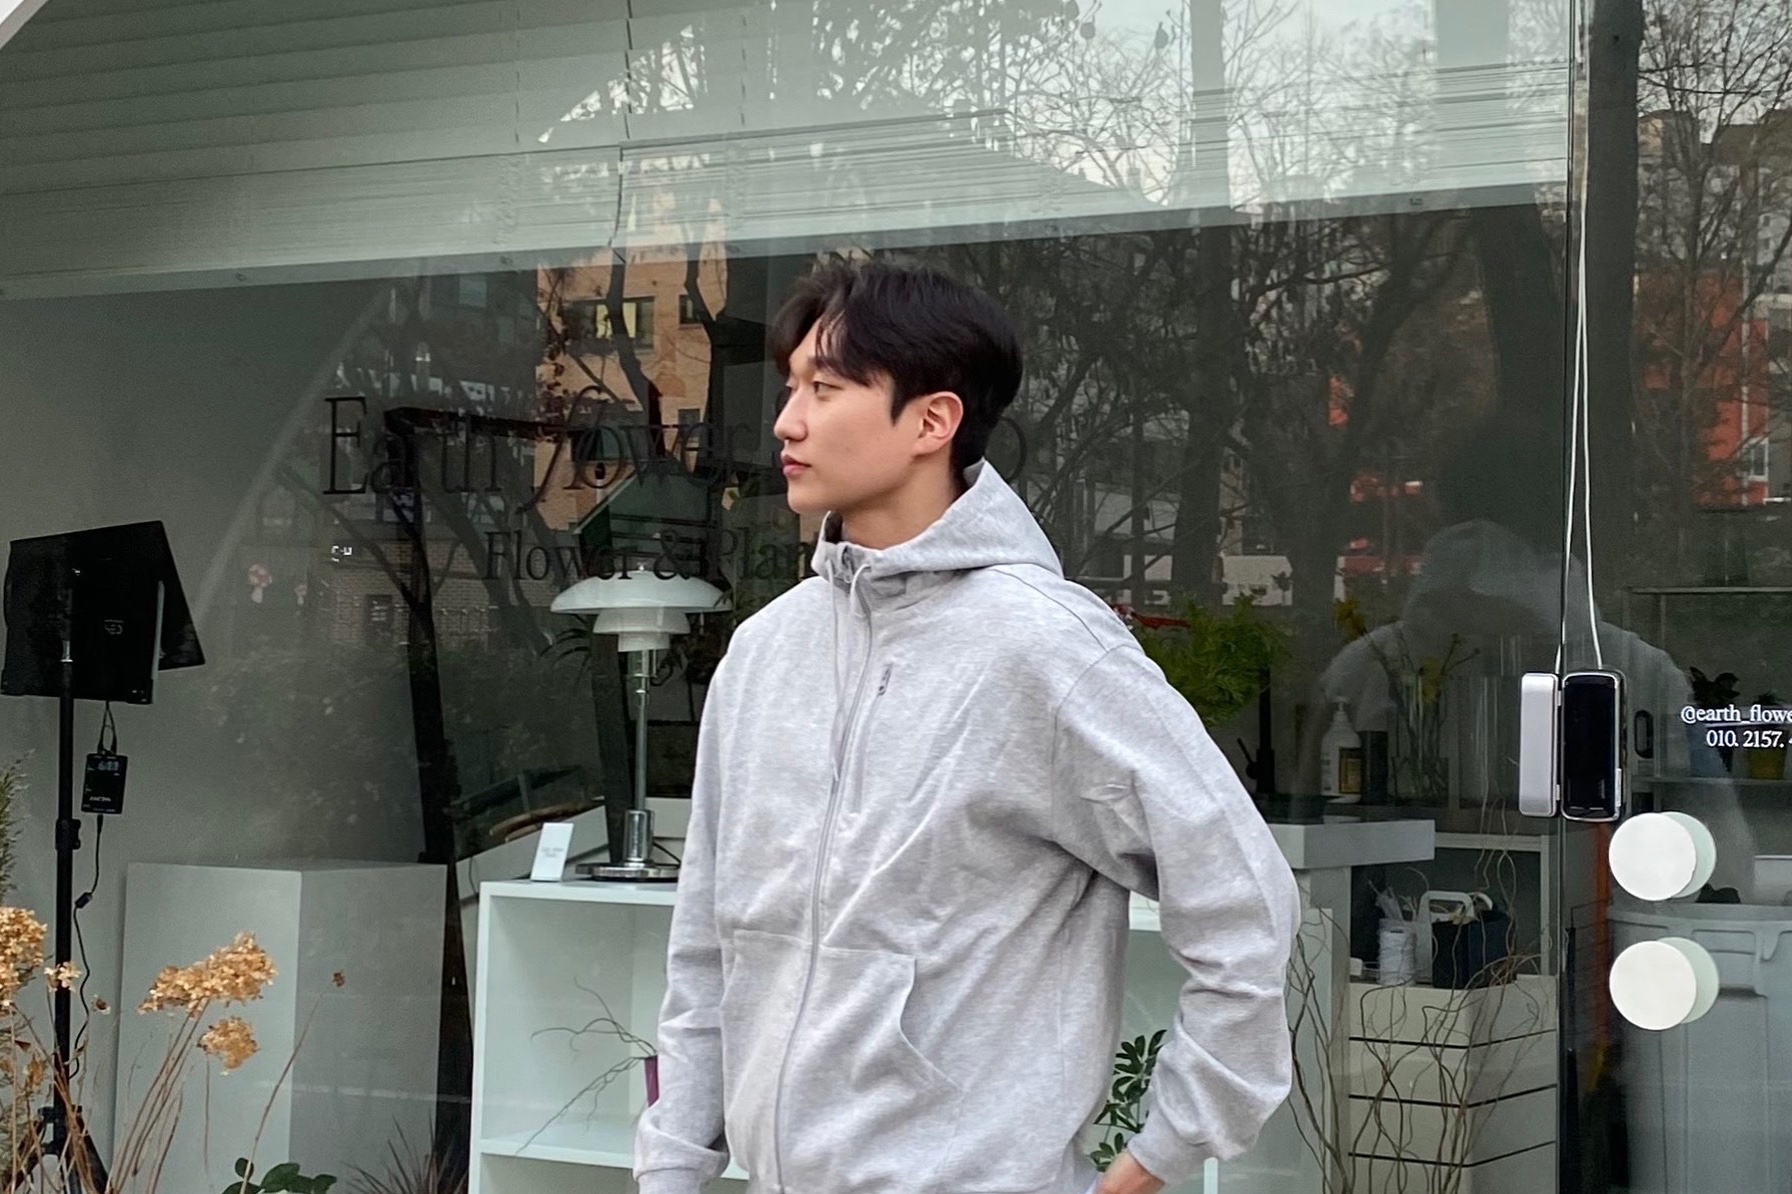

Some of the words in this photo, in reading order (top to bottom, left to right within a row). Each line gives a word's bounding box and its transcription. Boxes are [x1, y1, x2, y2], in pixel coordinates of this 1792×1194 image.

[483, 529, 632, 582] Flower
[653, 529, 695, 581] &
[1706, 729, 1740, 747] 010.
[1743, 730, 1785, 748] 2157.
